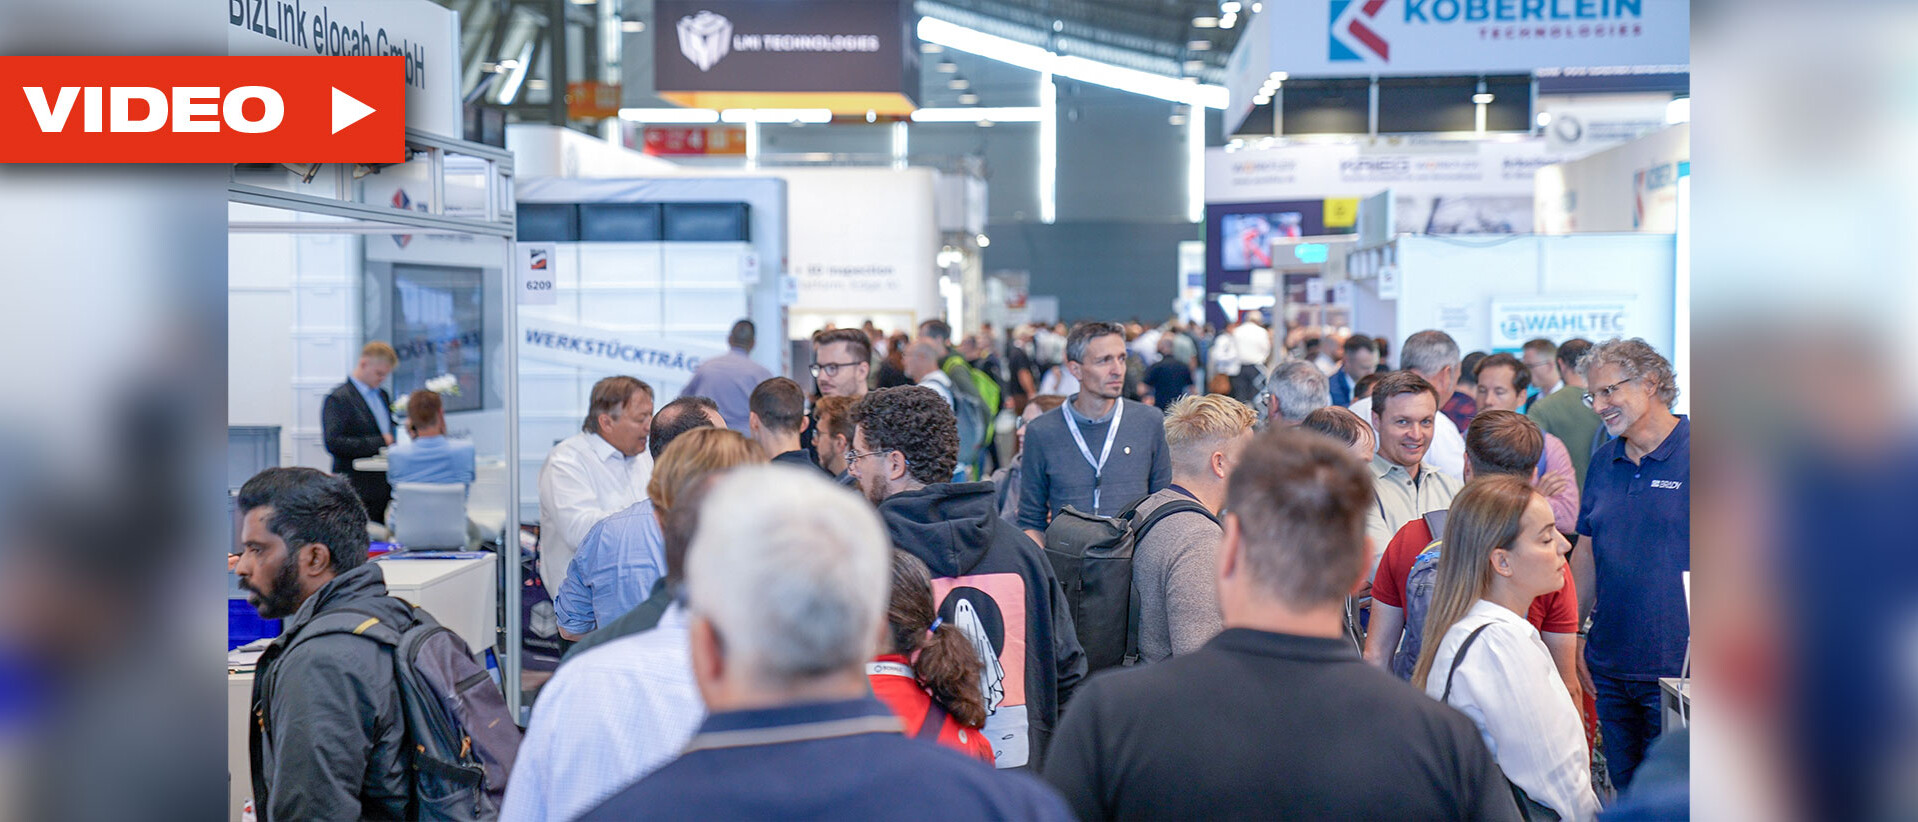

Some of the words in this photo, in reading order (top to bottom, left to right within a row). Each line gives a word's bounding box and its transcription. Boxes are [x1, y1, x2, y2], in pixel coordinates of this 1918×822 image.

[1479, 25, 1642, 40] TECHNOLOGIES
[733, 34, 762, 51] LMI
[763, 34, 880, 52] TECHNOLOGIES
[526, 281, 552, 291] 6209
[1525, 311, 1625, 332] WAHLTEC
[1658, 480, 1682, 489] BRADY
